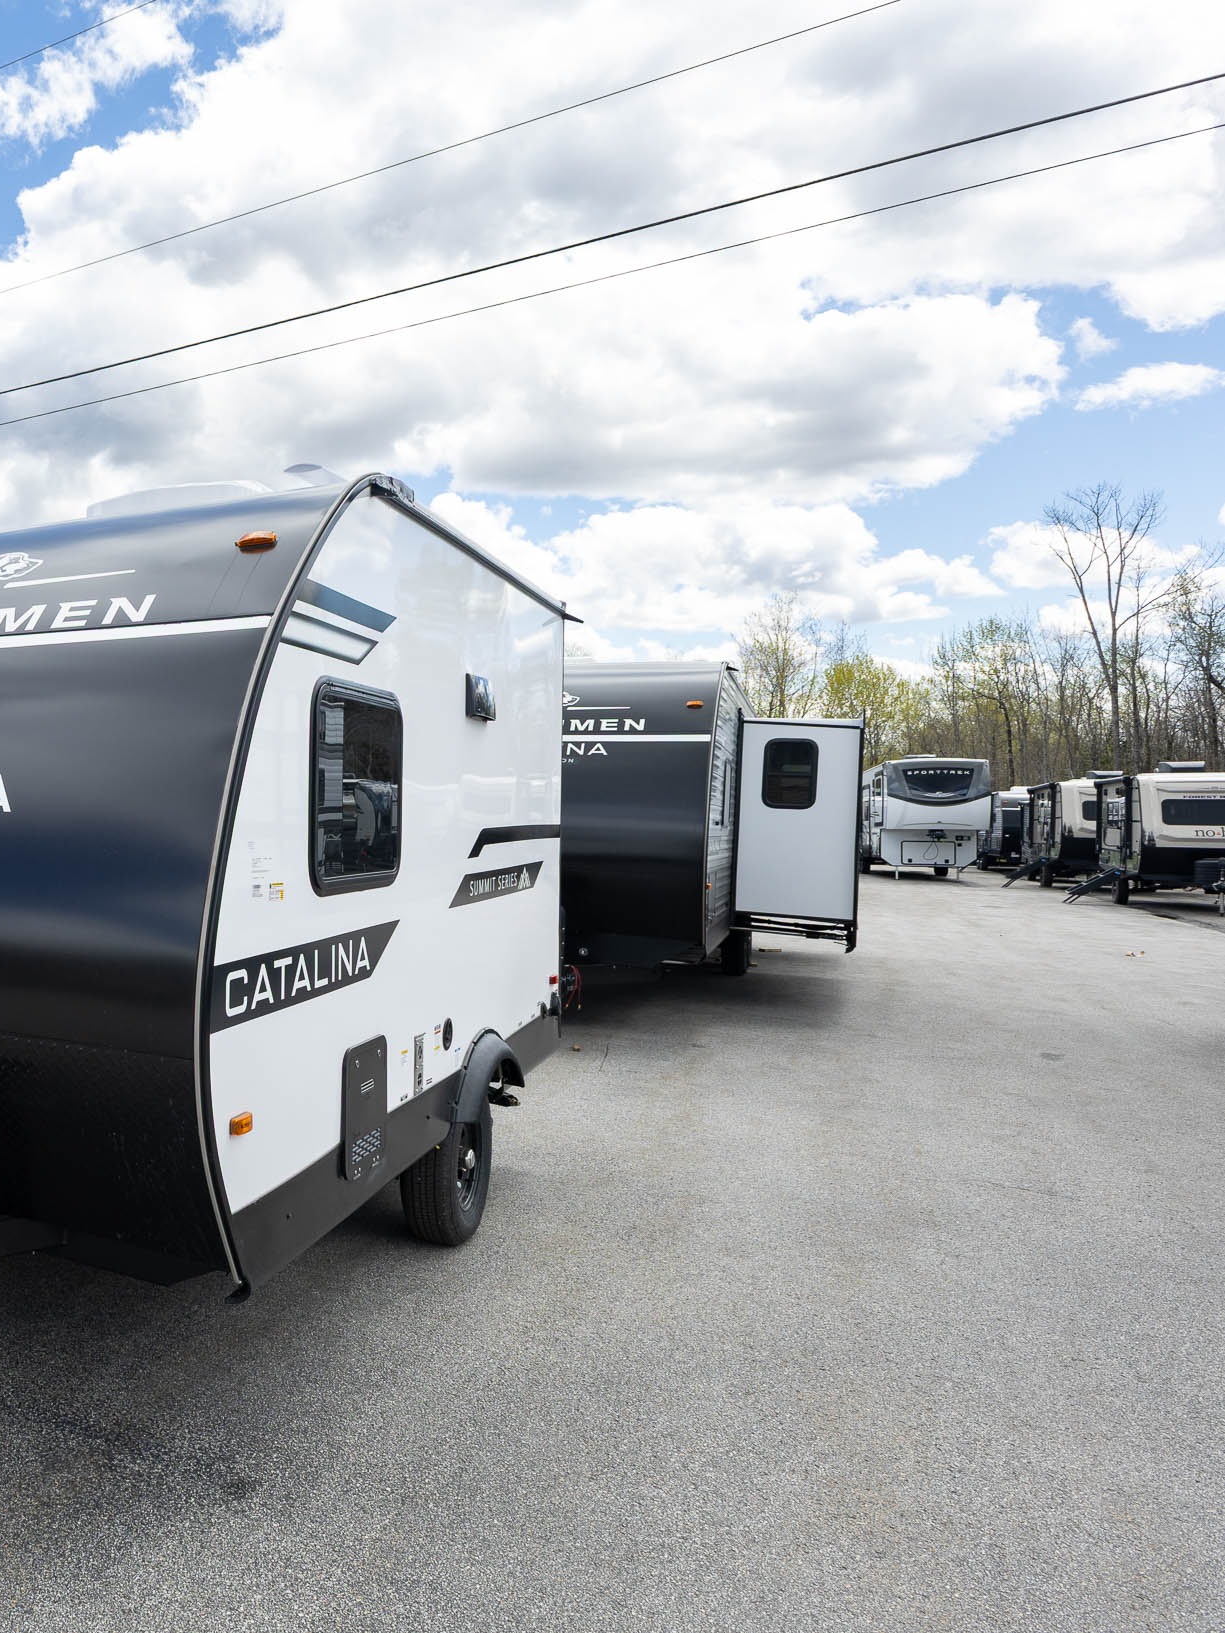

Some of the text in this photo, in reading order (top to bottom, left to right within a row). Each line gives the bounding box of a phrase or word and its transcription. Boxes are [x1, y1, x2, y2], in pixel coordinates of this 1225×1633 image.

[563, 719, 645, 731] MEN
[469, 872, 518, 897] SUMMIT SERIES
[225, 936, 371, 1018] CATALINA
